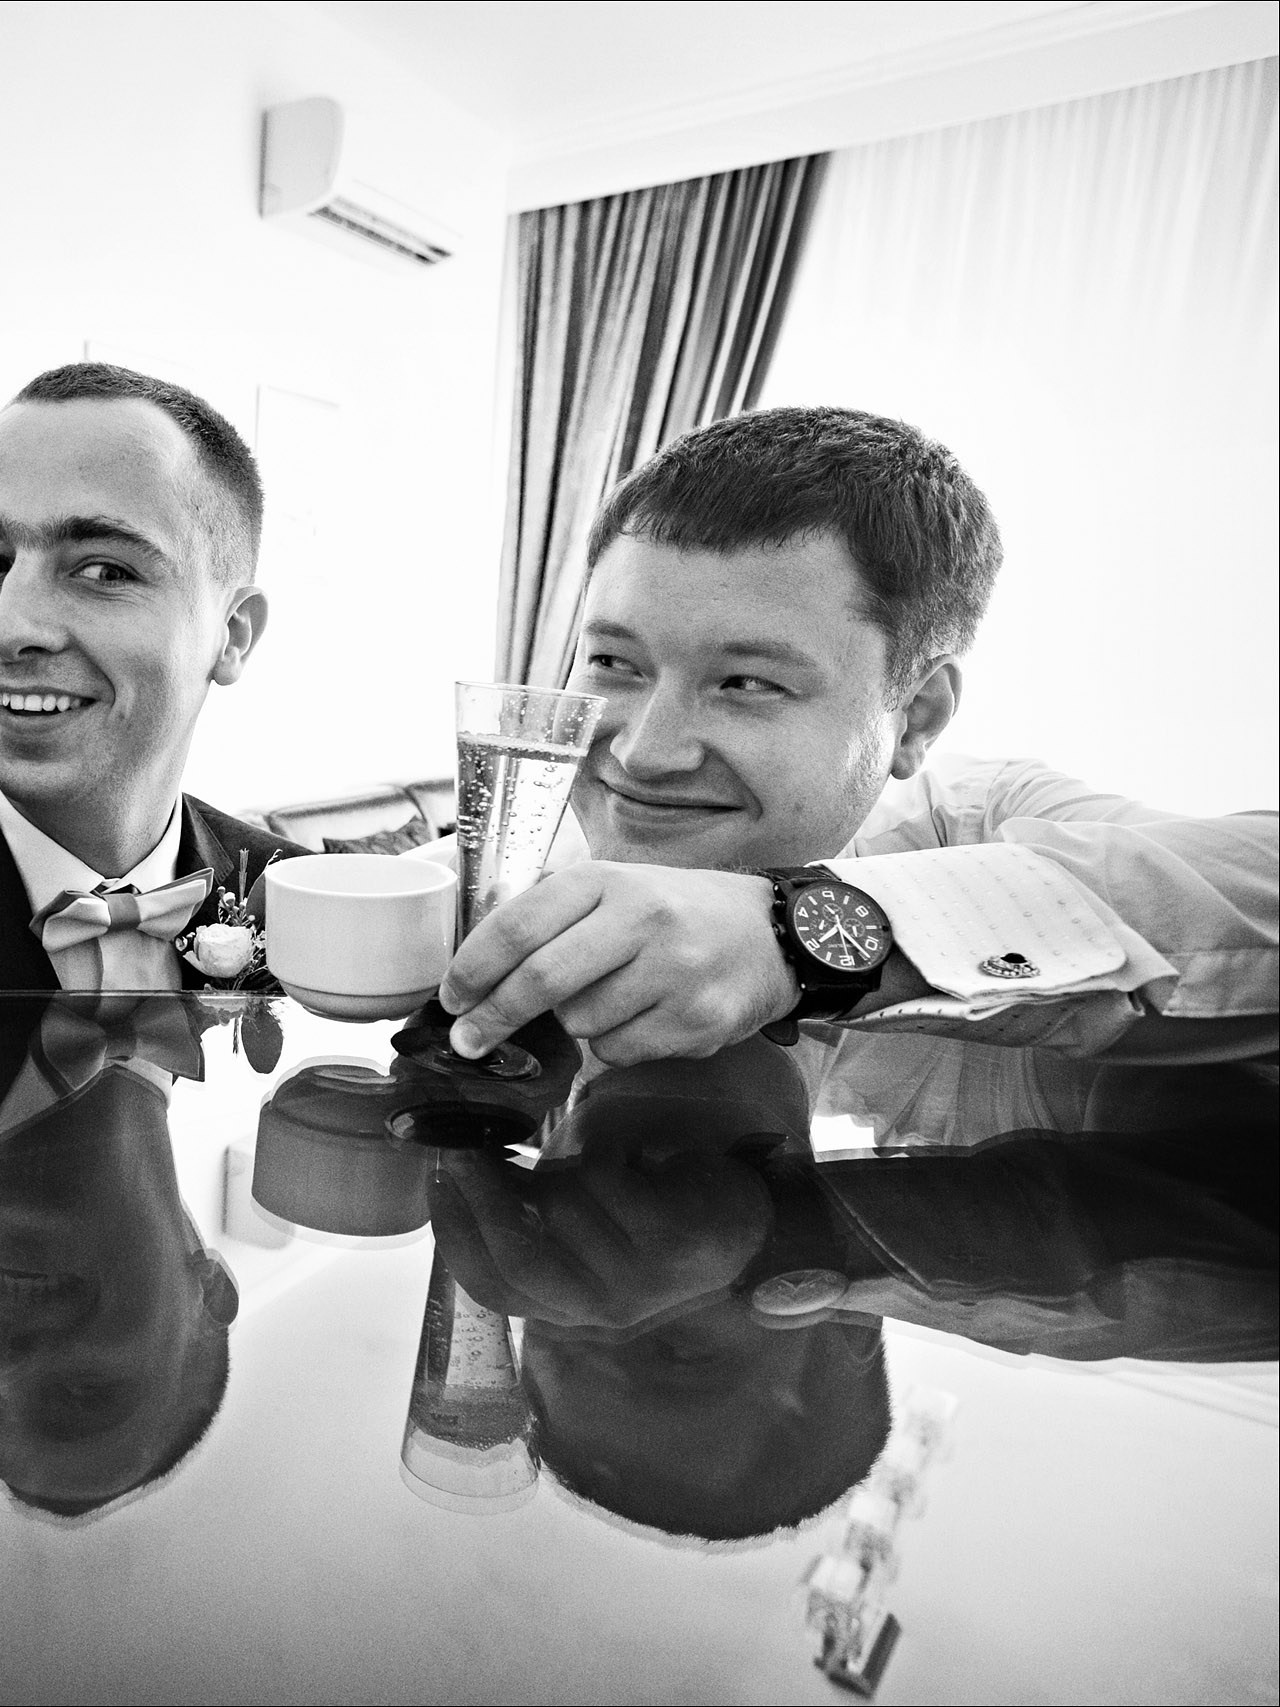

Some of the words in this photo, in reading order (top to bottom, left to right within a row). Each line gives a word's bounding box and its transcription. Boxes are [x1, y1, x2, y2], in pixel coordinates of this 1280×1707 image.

[797, 906, 809, 919] 4
[855, 905, 869, 918] 8
[806, 938, 820, 951] 2
[865, 936, 879, 951] 10
[839, 955, 856, 966] 12
